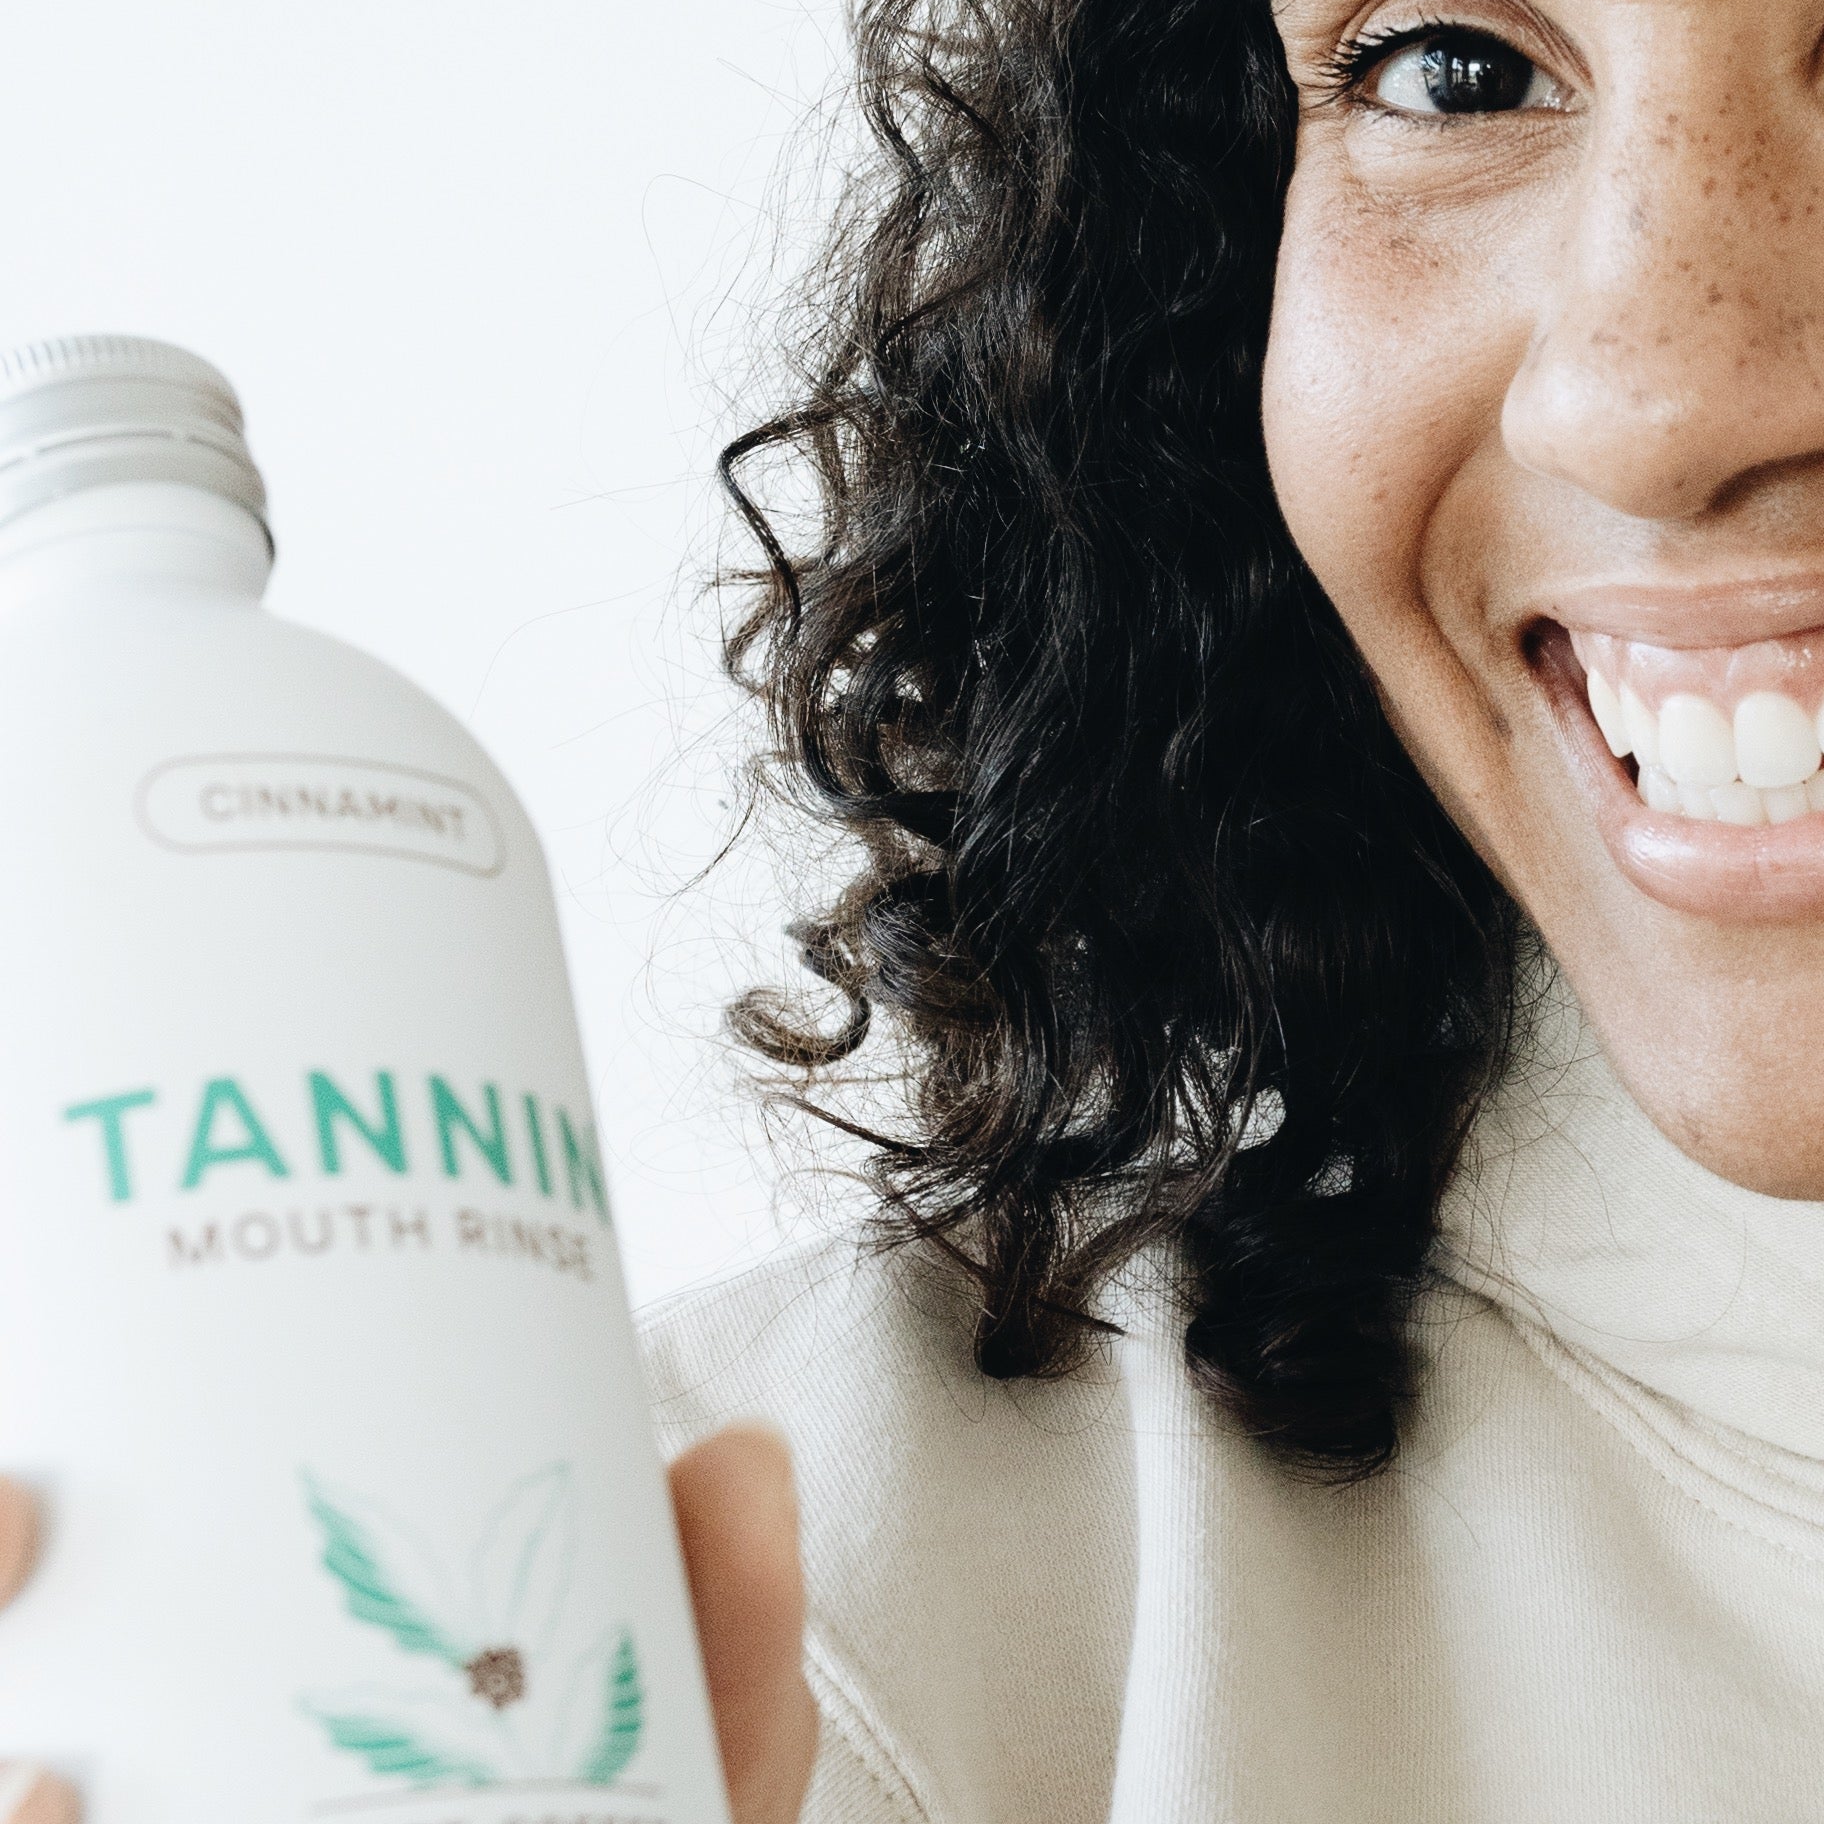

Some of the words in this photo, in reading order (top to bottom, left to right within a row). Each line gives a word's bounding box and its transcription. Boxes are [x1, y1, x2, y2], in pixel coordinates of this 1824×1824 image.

[198, 782, 466, 840] CINNAMINT
[61, 1068, 612, 1229] TANNIN
[164, 1205, 432, 1270] MOUTH
[454, 1206, 594, 1284] RINSE
